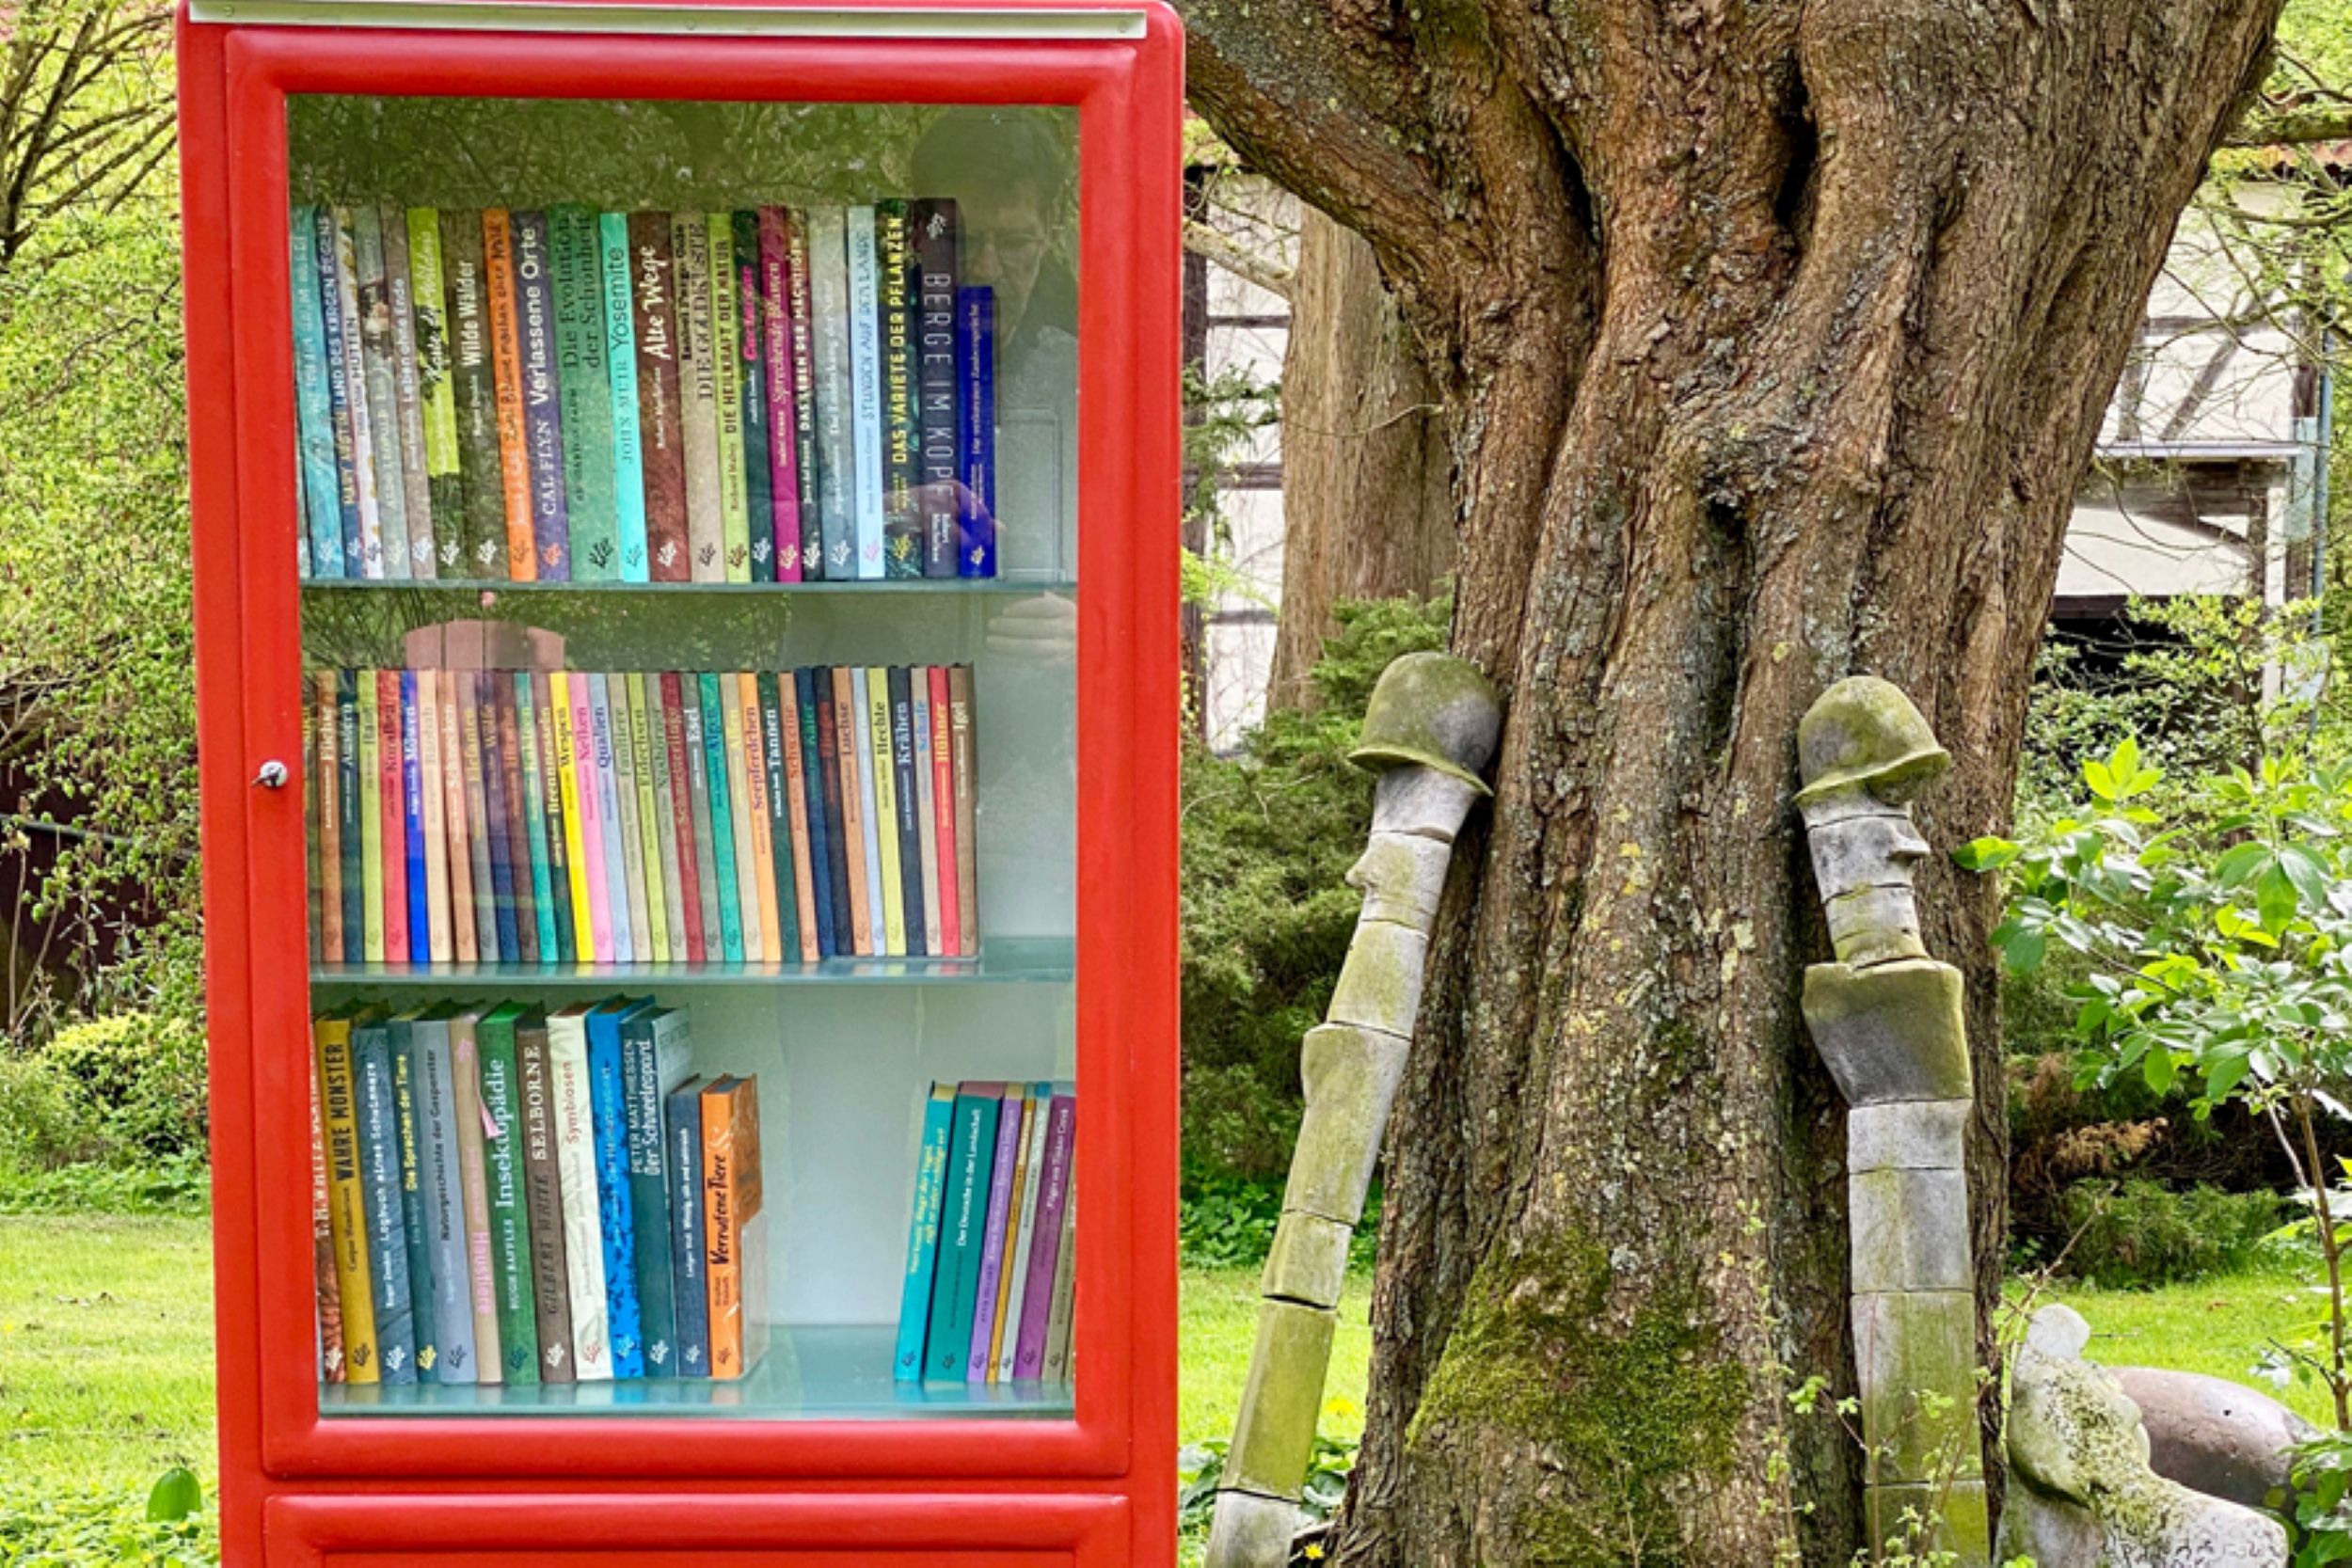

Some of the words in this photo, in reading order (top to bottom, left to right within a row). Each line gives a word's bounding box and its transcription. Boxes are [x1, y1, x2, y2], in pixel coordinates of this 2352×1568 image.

[519, 228, 537, 279] Orte
[557, 217, 576, 324] Evolution
[638, 245, 667, 312] Wege
[715, 241, 730, 289] NATUR
[886, 217, 904, 306] PFLANZEN
[393, 278, 406, 314] Ende
[456, 261, 477, 316] Wälder
[608, 247, 630, 351] Yosemite
[717, 293, 731, 321] DER
[397, 317, 409, 352] ohne
[461, 320, 482, 367] Wilde
[643, 317, 670, 359] Alte
[890, 312, 905, 348] DER
[924, 273, 951, 365] BERGE
[330, 338, 342, 366] DES
[523, 286, 548, 406] Verlassene
[562, 329, 580, 369] Die
[581, 330, 600, 369] der
[719, 326, 736, 404] HEILKRAFT
[333, 371, 346, 405] LAND
[400, 353, 414, 403] Leben
[696, 358, 714, 400] DIE
[925, 381, 952, 410] IM
[723, 409, 737, 434] DIE
[799, 405, 810, 431] DAS
[537, 420, 553, 470] FLYN
[893, 430, 907, 463] DAS
[926, 426, 954, 497] KOPF
[542, 476, 556, 515] CAL
[383, 705, 398, 772] Korallen
[557, 707, 572, 768] Wespen
[576, 706, 589, 760] Nelken
[595, 707, 610, 768] Quallen
[684, 707, 699, 742] Esel
[766, 709, 781, 770] Tannen
[837, 702, 851, 756] Luchse
[874, 702, 888, 755] Hechte
[895, 702, 911, 766] Krähen
[934, 702, 948, 762] Hühner
[951, 702, 968, 731] Igel
[444, 705, 458, 788] Schnecken
[633, 709, 650, 786] Eidechsen
[743, 706, 764, 811] Seepferdchen
[326, 1044, 349, 1119] MONSTER
[396, 1054, 409, 1085] Tiere
[425, 1049, 440, 1117] Gespenster
[399, 1089, 411, 1109] der
[524, 1046, 546, 1161] SELBORNE
[562, 1061, 580, 1145] Symbiosen
[331, 1128, 356, 1182] WAHRE
[402, 1111, 417, 1168] Sprachen
[430, 1121, 441, 1140] der
[487, 1059, 515, 1209] Insektopädie
[628, 1132, 644, 1174] PETER
[966, 1109, 981, 1158] Landschaft
[405, 1171, 418, 1191] Die
[644, 1150, 661, 1176] Der
[707, 1154, 728, 1189] Tiere
[965, 1159, 976, 1176] der
[376, 1188, 391, 1242] Logbuch
[433, 1144, 452, 1242] Naturgeschichte
[708, 1191, 730, 1265] Verrufene
[957, 1229, 967, 1247] Der
[472, 1230, 491, 1315] Haustiere
